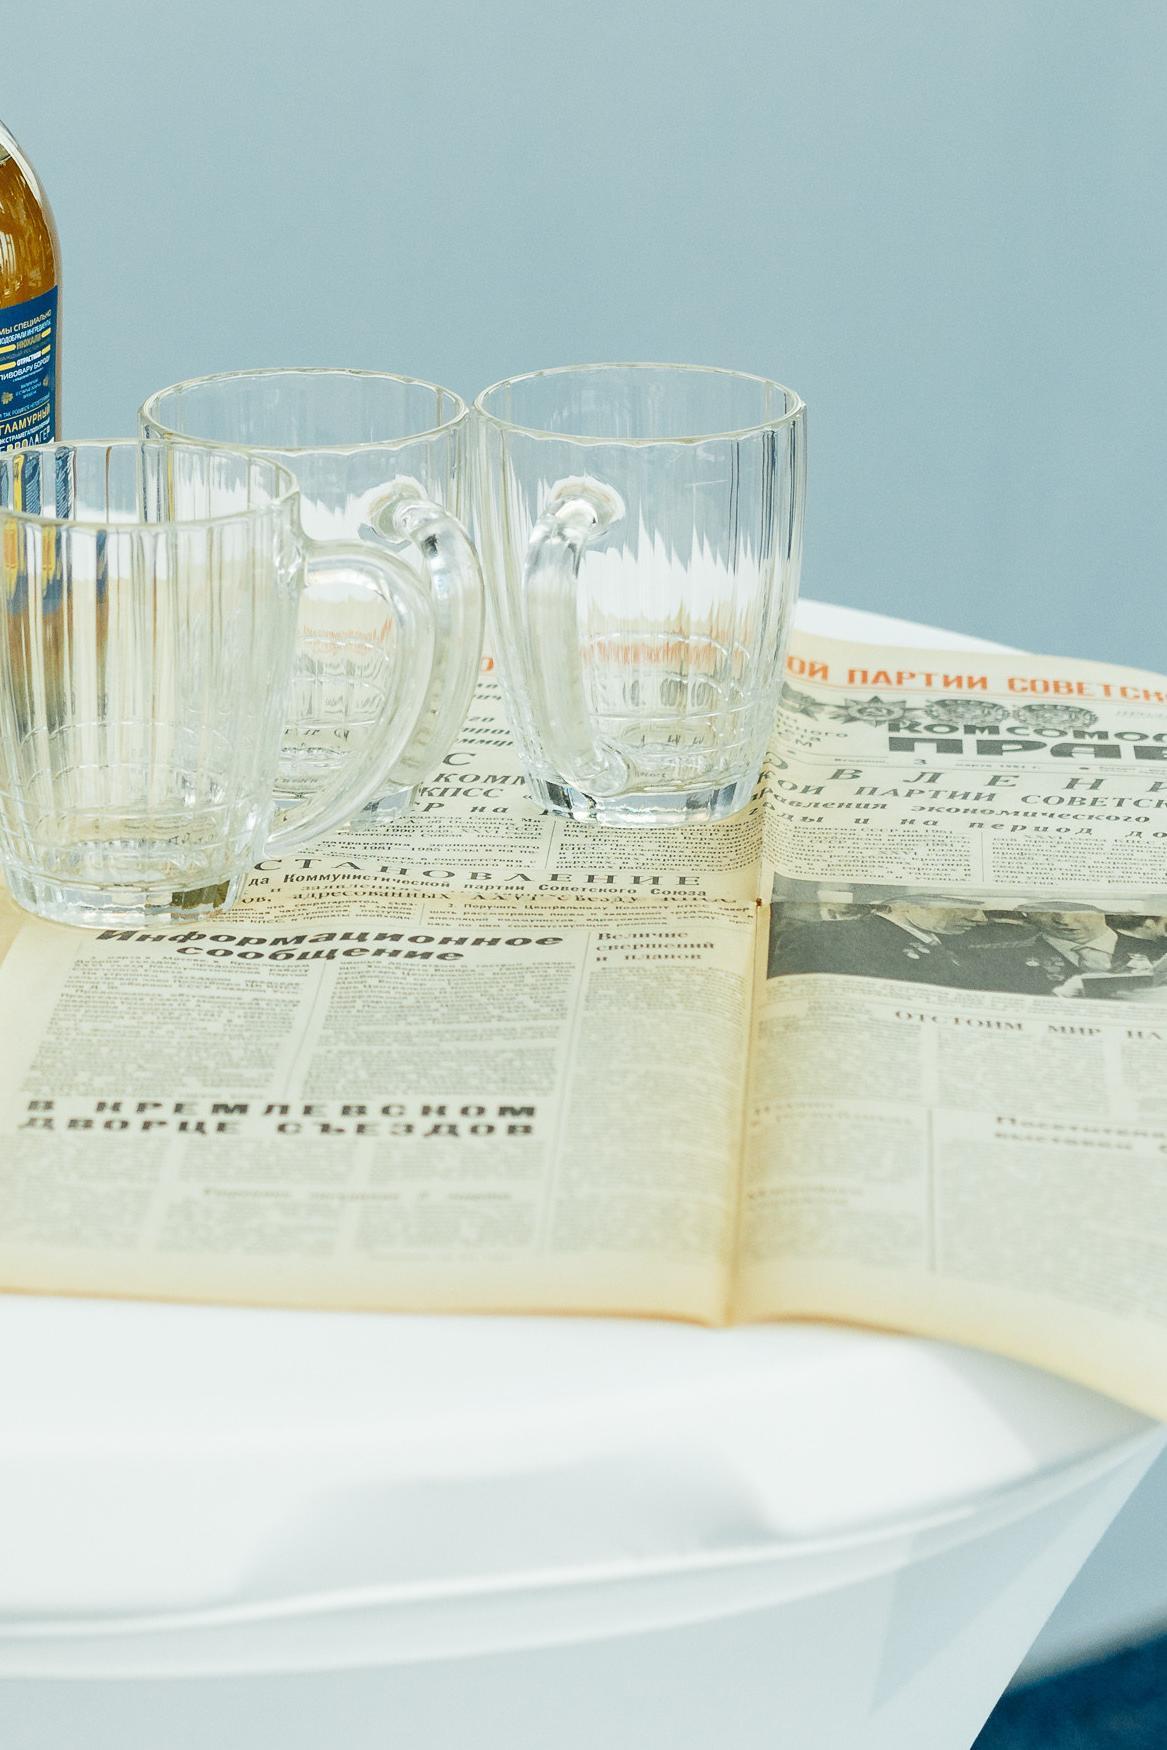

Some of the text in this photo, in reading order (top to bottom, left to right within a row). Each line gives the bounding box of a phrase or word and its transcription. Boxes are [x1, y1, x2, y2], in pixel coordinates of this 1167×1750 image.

[14, 309, 51, 332] СПЕЦИАЛЬНО
[847, 668, 989, 691] ПАРТИИ
[1007, 677, 1167, 706] СОВЕТСК
[913, 757, 928, 766] 3
[855, 785, 997, 803] ПАРТИИ
[470, 805, 509, 813] на
[911, 803, 1150, 823] экономического
[900, 817, 939, 827] на
[967, 822, 1093, 836] период
[283, 873, 450, 889] Коммунистической
[538, 884, 637, 895] Советского
[651, 887, 707, 896] Союза
[293, 891, 451, 900] адресованных
[96, 930, 564, 948] Информационное
[596, 940, 715, 951] свершений
[598, 932, 689, 941] Величие
[176, 946, 464, 962] сообщение
[625, 953, 703, 962] планов
[894, 1009, 1025, 1032] ОТСТОИМ
[1048, 1024, 1102, 1036] МИР
[27, 1099, 536, 1118] В КРЕМЛЕВСКОМ
[17, 1116, 533, 1138] ДВОРЦЕ СЪЕЗДОВ
